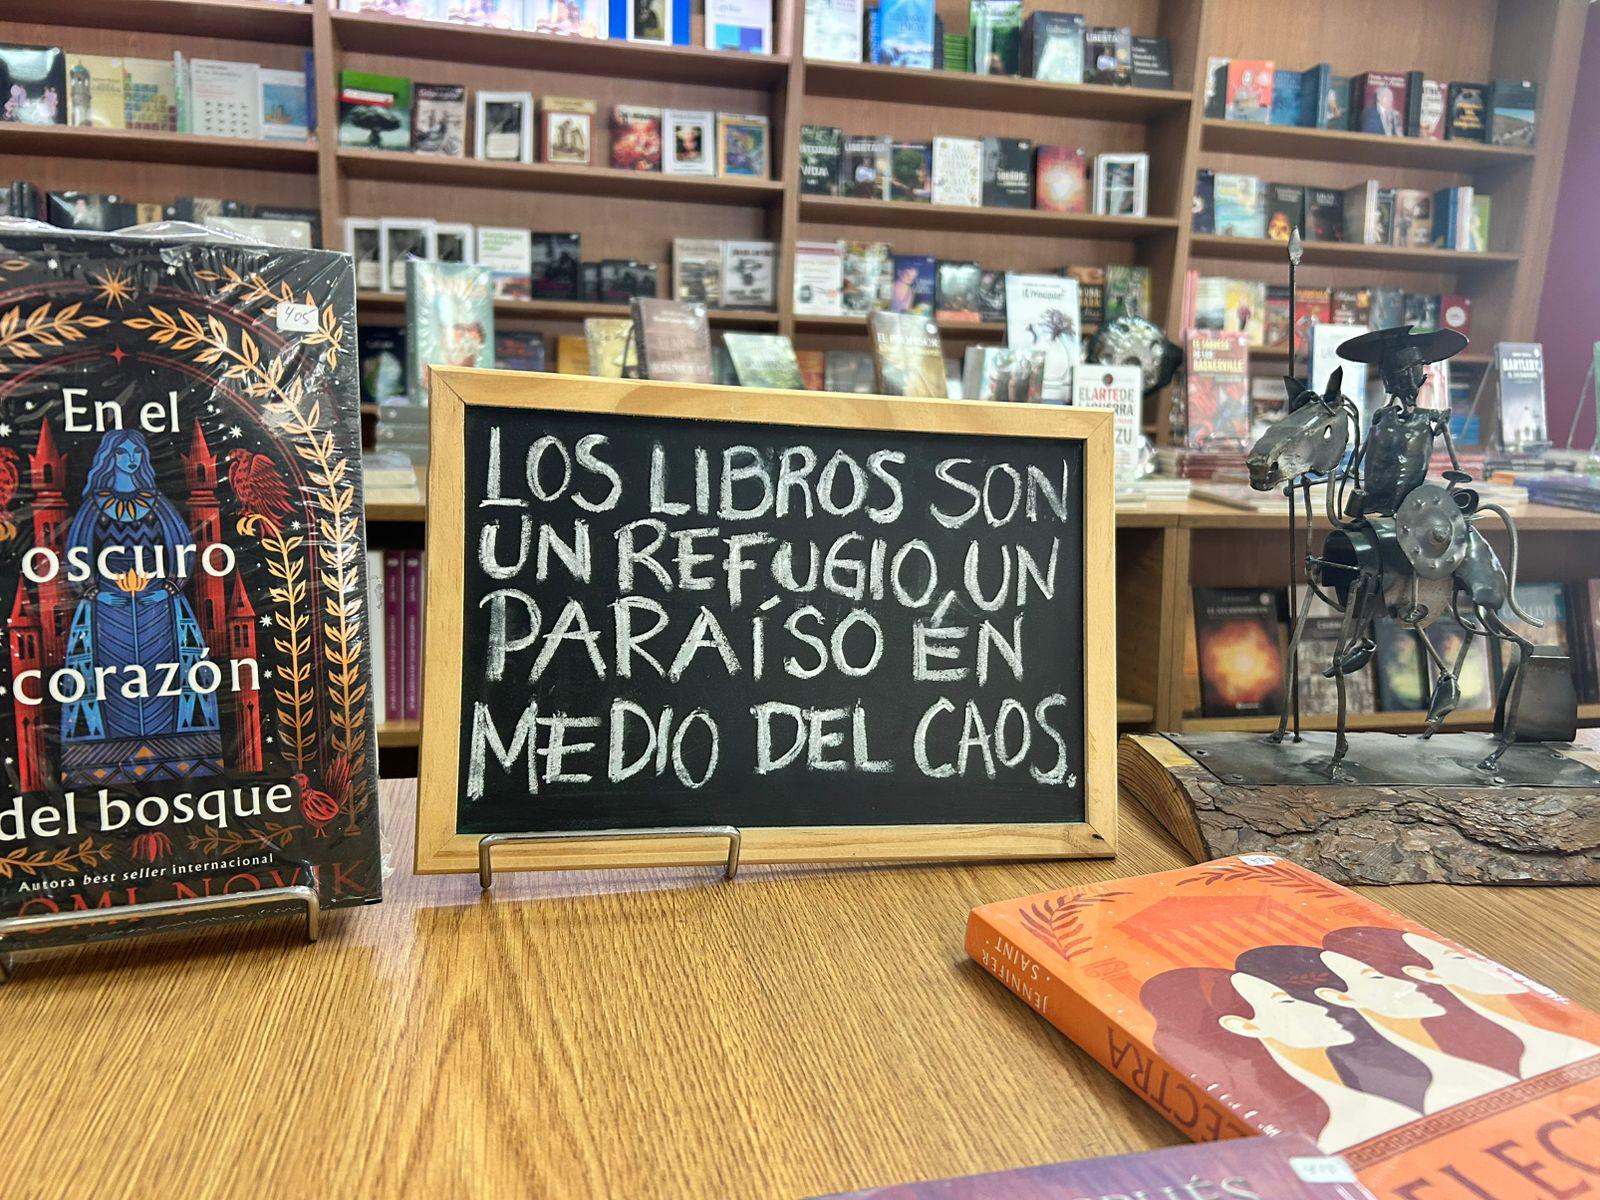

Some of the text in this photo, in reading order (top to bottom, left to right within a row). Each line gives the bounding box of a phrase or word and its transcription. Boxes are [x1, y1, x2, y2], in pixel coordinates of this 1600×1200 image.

[62, 388, 181, 433] En el
[478, 426, 1068, 529] LOS LIBROS SON
[21, 541, 236, 584] oscuro
[478, 514, 591, 585] UN
[964, 536, 1060, 612] UN
[479, 587, 884, 684] PARAÍSO
[12, 647, 261, 706] corazón
[467, 692, 1077, 801] MEDIO DEL CAOS.
[0, 783, 293, 842] del bosque
[18, 852, 274, 894] Autora best seller internacional
[982, 949, 1049, 1013] JENNIFER
[994, 936, 1041, 981] SAINT
